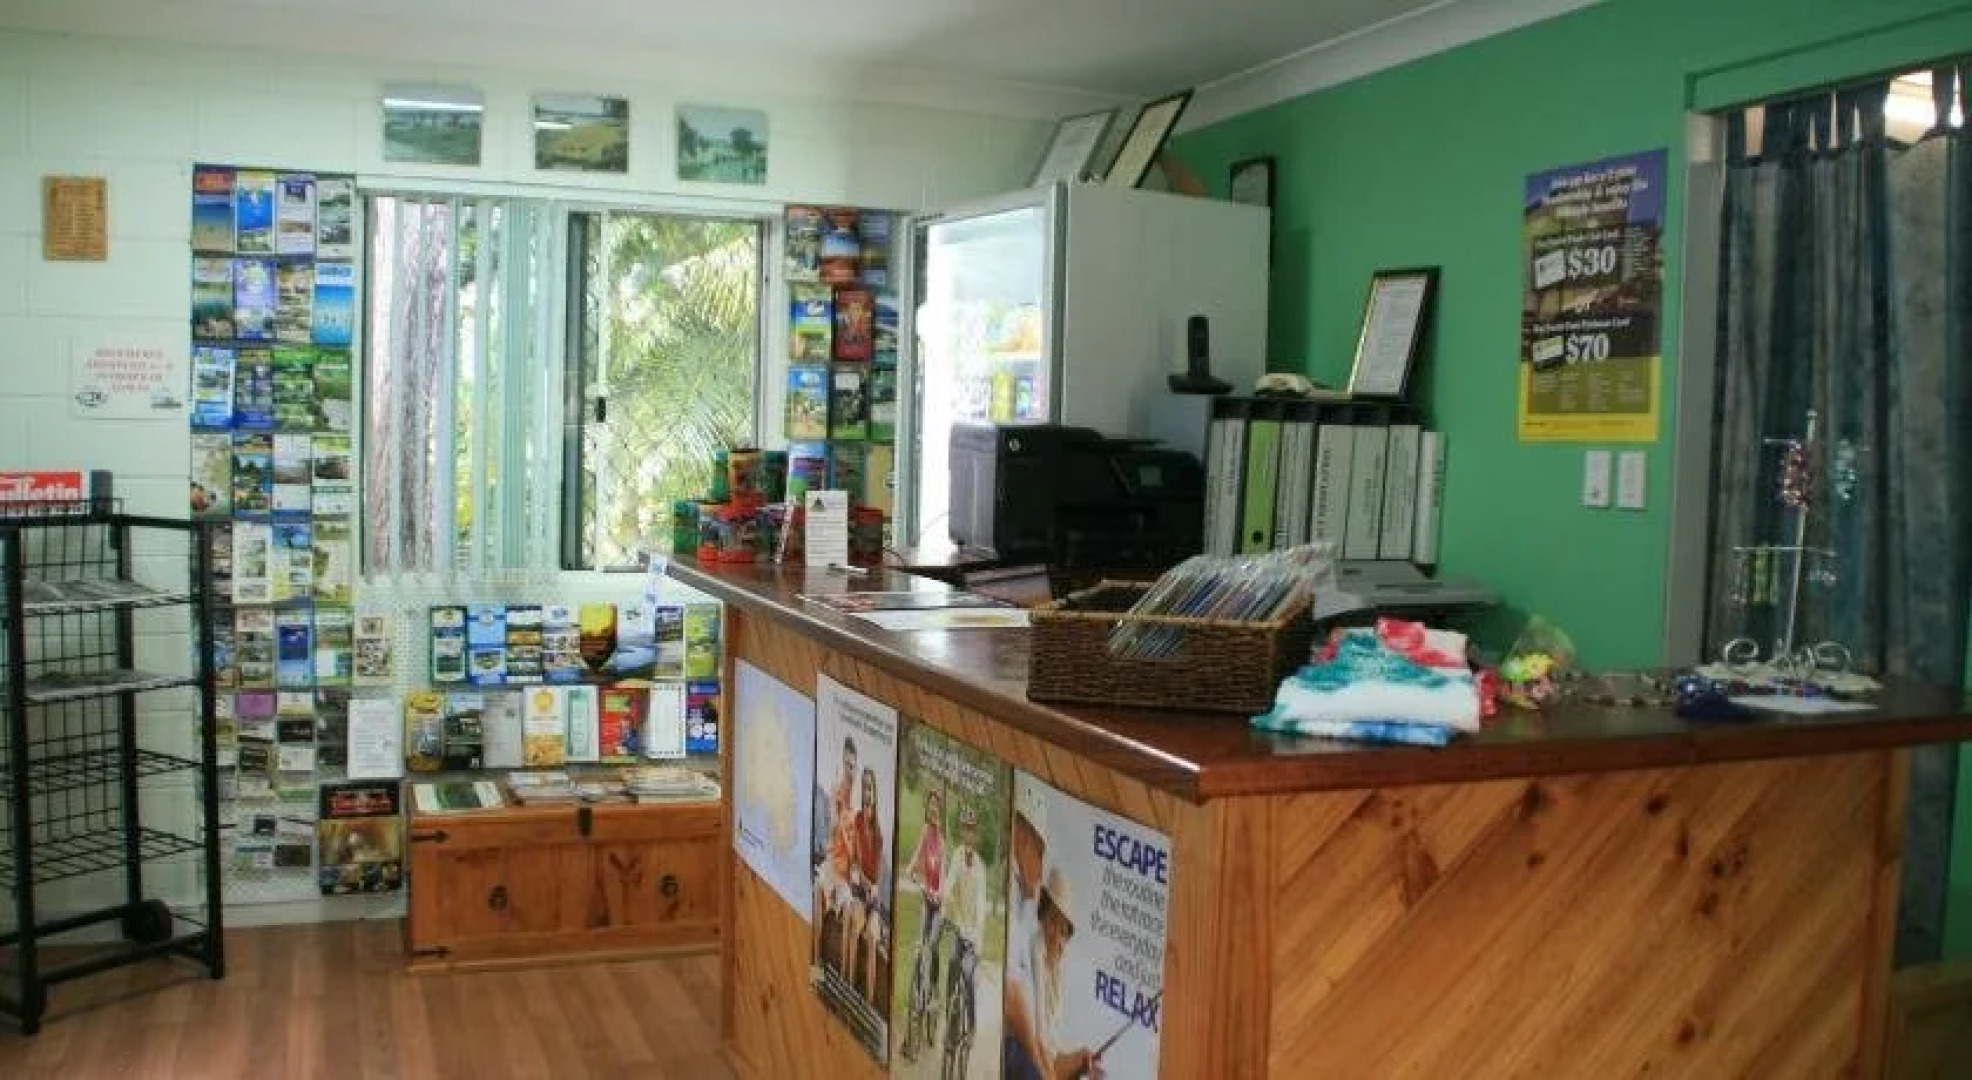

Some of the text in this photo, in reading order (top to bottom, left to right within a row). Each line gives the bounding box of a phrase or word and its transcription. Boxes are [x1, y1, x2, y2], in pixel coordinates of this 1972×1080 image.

[1567, 245, 1616, 280] $30
[1566, 332, 1610, 364] $70
[1093, 823, 1168, 885] ESCAPE
[1095, 969, 1159, 1034] RELAX
